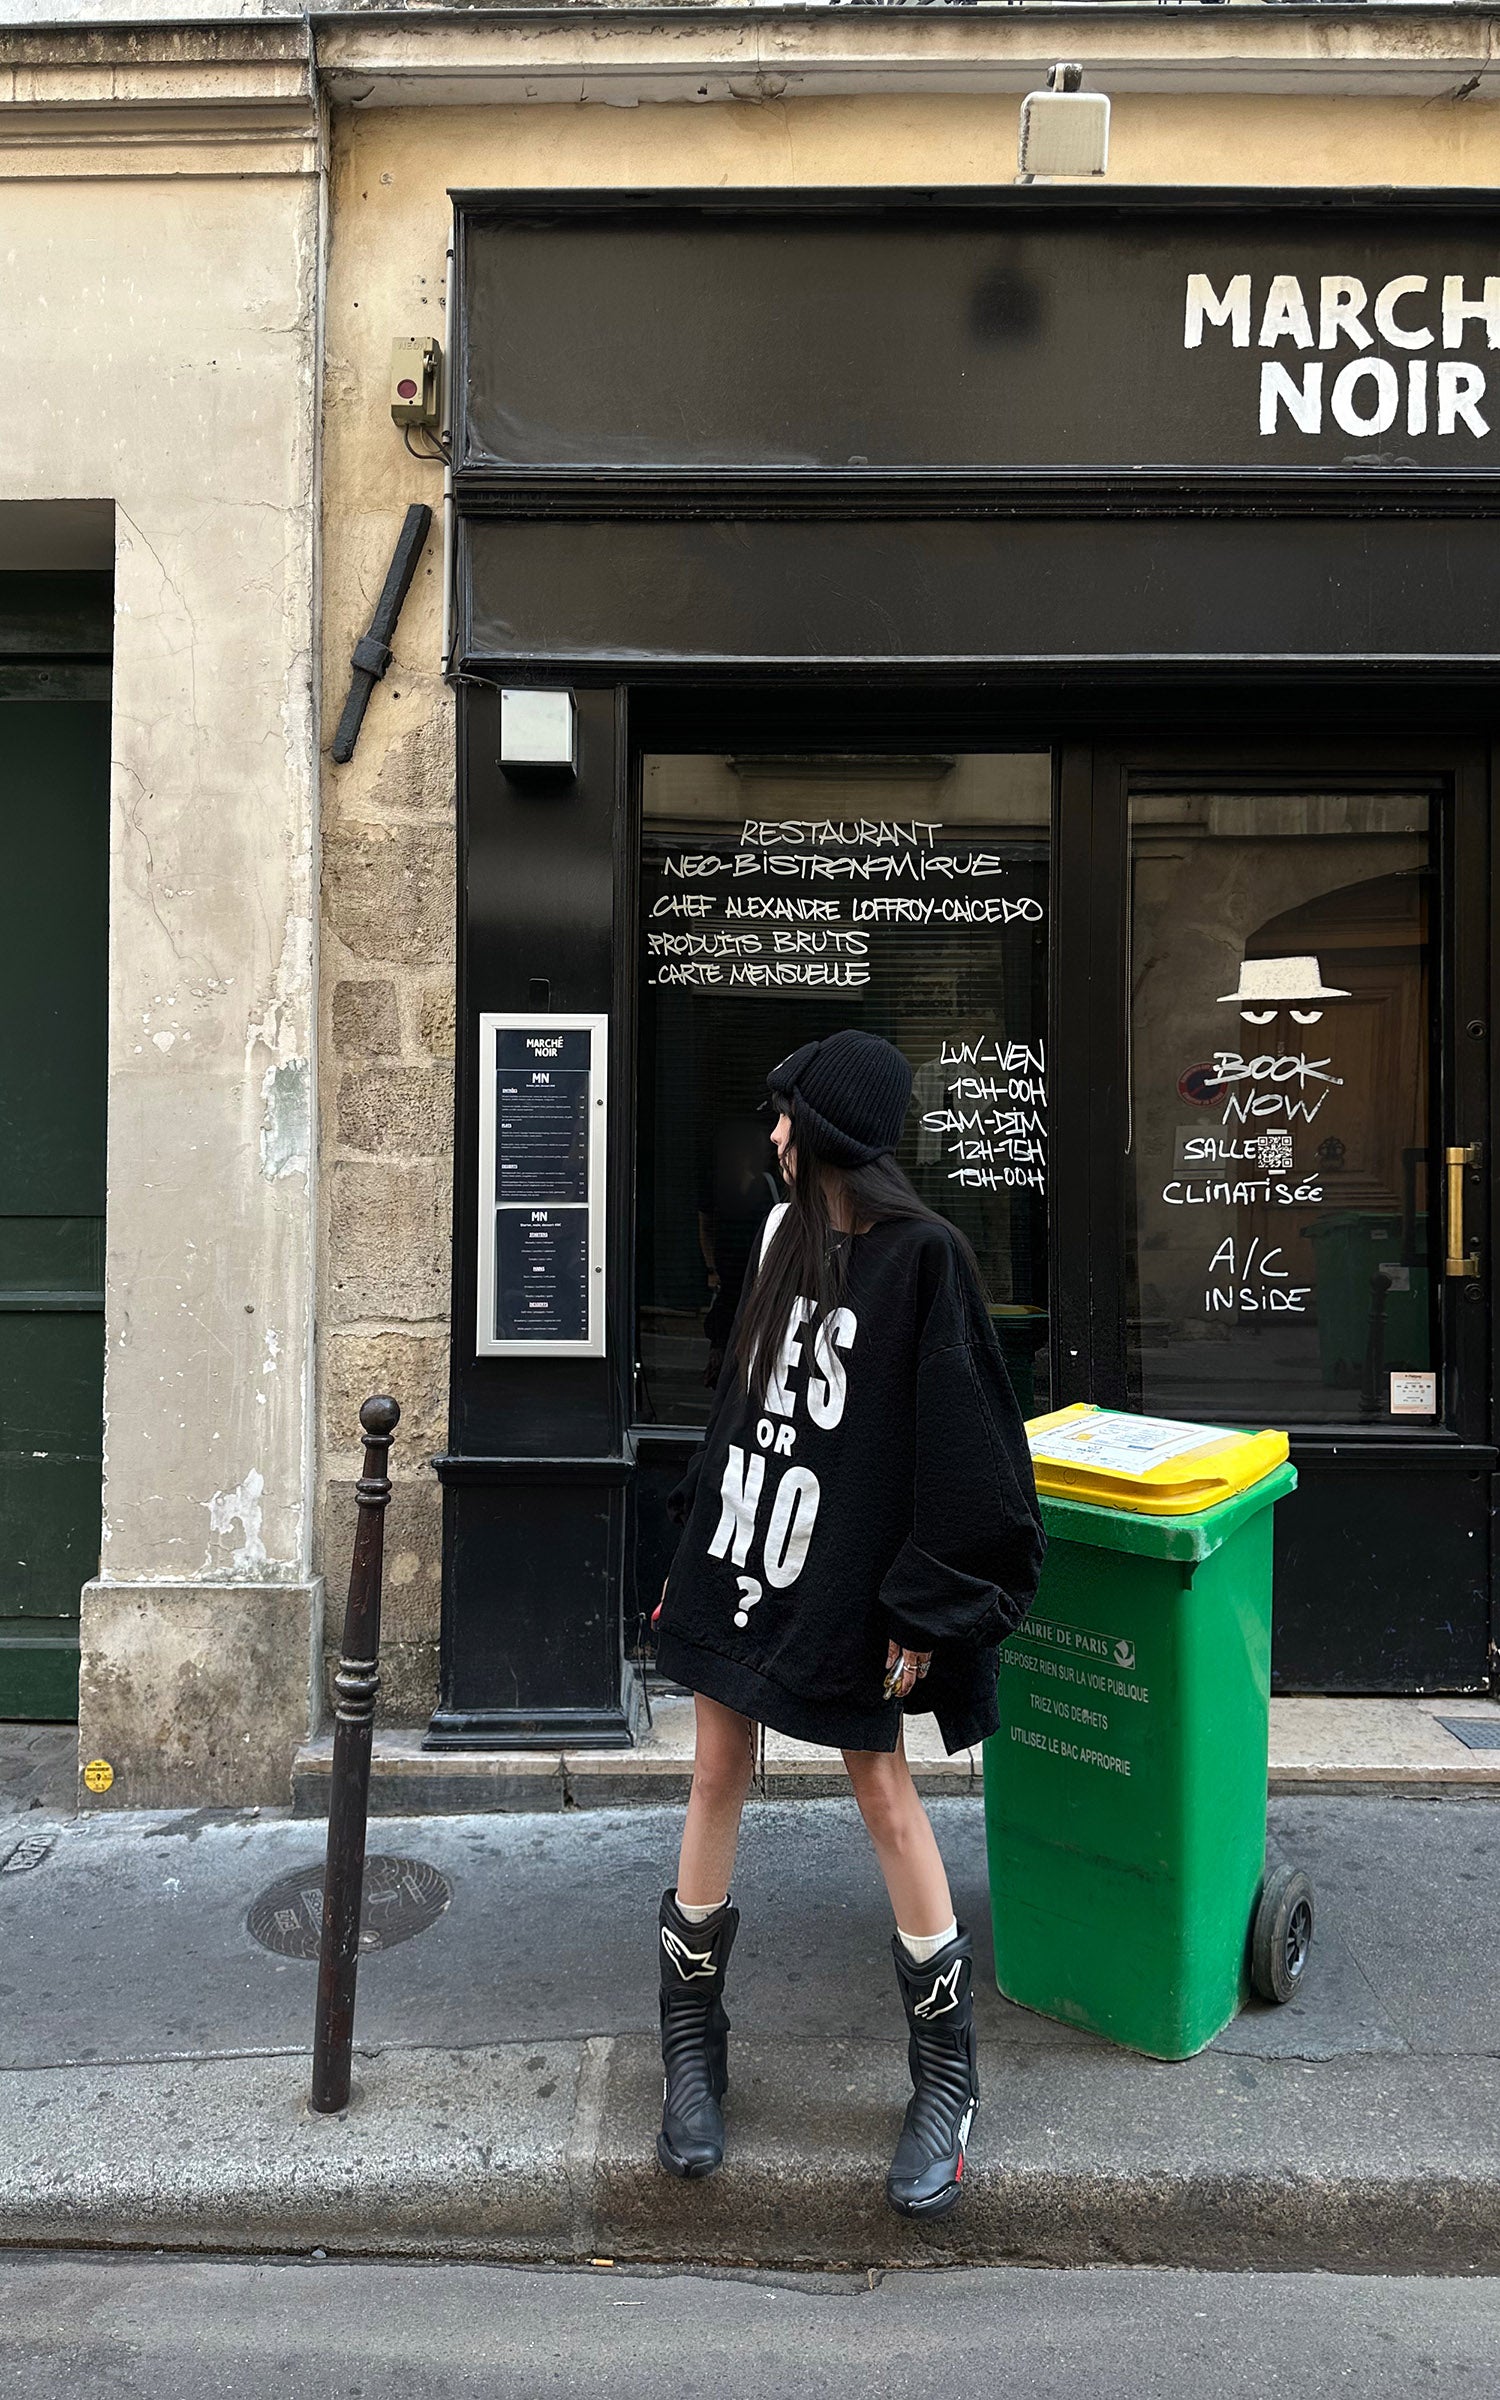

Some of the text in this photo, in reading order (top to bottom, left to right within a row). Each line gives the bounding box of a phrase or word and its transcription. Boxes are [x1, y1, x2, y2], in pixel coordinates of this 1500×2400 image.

[1259, 356, 1491, 439] NOIR
[740, 818, 943, 848] RESTAURANT
[725, 896, 841, 922] ALEXANDRE
[773, 930, 871, 955] BRUTS
[730, 961, 871, 986] MENSUELLE
[526, 1035, 564, 1048] MARCHÉ
[534, 1047, 558, 1057] NOIR
[940, 1035, 1045, 1074] LUN-VEN
[532, 1072, 550, 1084] MN
[1204, 1052, 1344, 1090] BOOK
[1221, 1087, 1330, 1125] NOW
[1184, 1137, 1258, 1162] SALLE
[531, 1211, 548, 1222] MN
[1208, 1236, 1289, 1281] A/C
[747, 1295, 858, 1431] ES
[756, 1418, 796, 1457] OR
[707, 1444, 820, 1589] NO
[733, 1575, 763, 1628] ?
[1056, 1628, 1072, 1646] DE
[1075, 1634, 1109, 1656] PARIS
[1004, 1649, 1039, 1672] DEPOSEZ
[1039, 1659, 1058, 1677] RIEN
[1058, 1664, 1075, 1683] SUR
[1076, 1669, 1087, 1687] LA
[1087, 1673, 1106, 1692] VOIE
[1107, 1678, 1150, 1704] PUBLIQUE
[1030, 1693, 1109, 1731] TRIEZ VOS DECHETS
[1010, 1725, 1132, 1777] UTILISEZ LE BAC APPROPRIE
